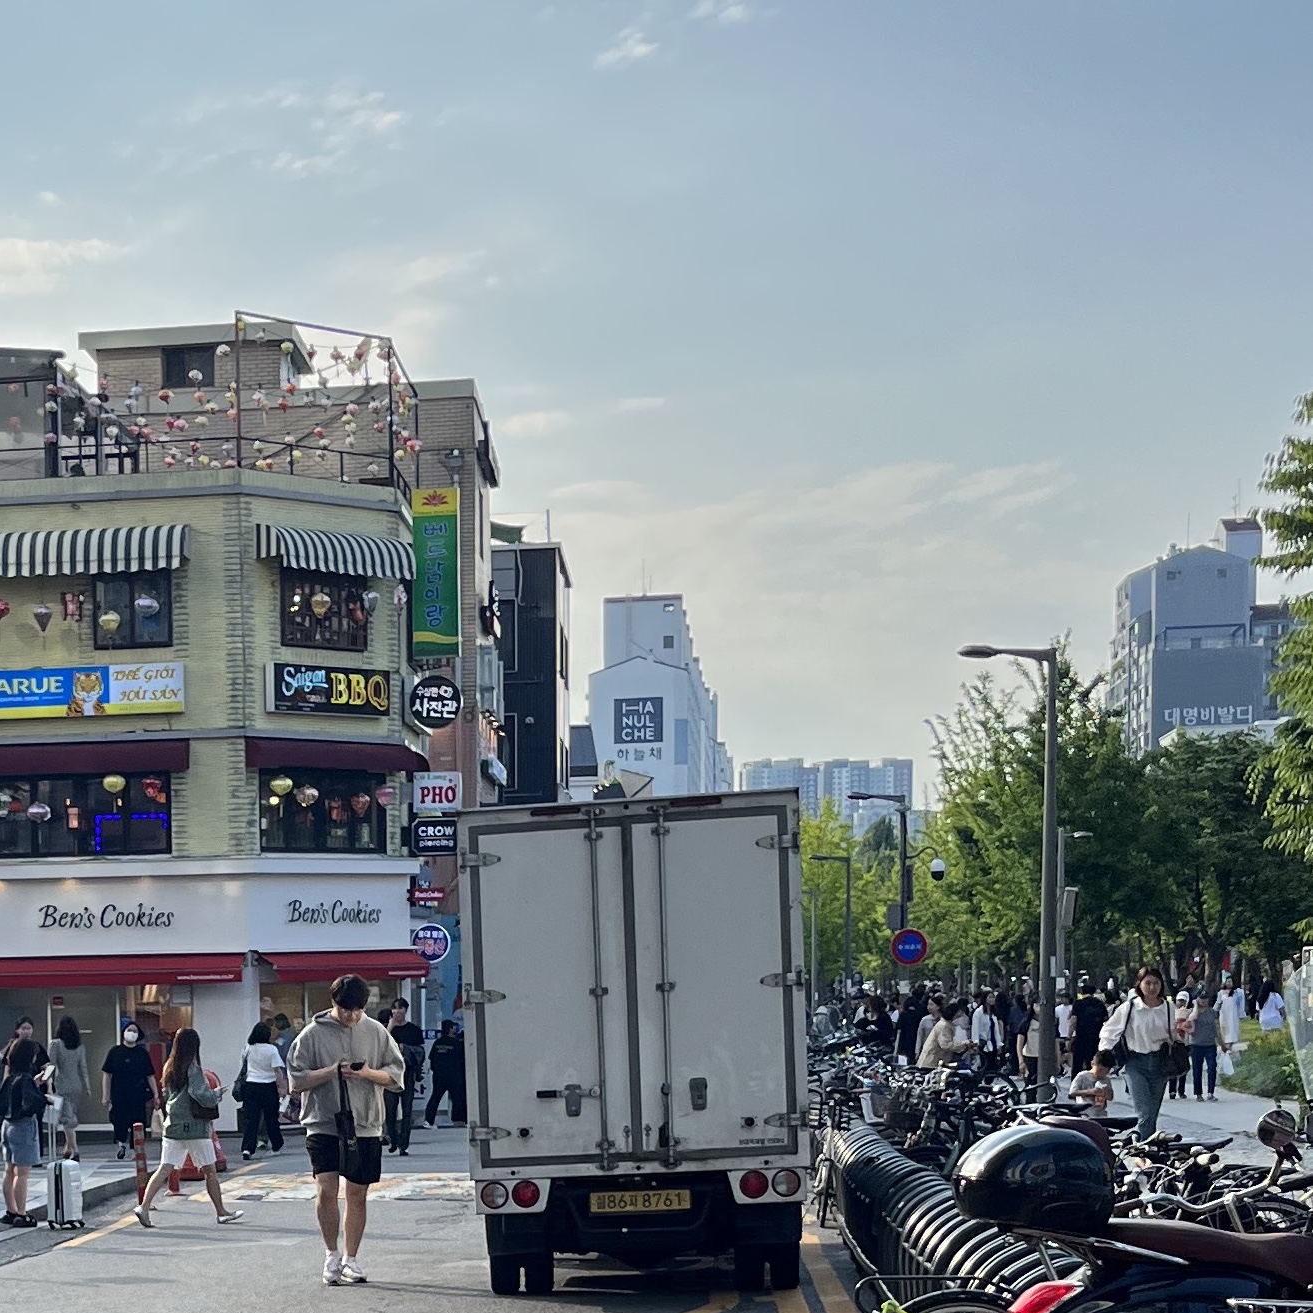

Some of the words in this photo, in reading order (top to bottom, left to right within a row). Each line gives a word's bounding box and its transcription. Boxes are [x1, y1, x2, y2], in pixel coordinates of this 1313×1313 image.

[330, 672, 388, 711] BBQ
[411, 697, 458, 719] 사진관
[622, 700, 655, 714] HA
[1163, 705, 1253, 726] 대명비발디
[622, 714, 655, 728] NUL
[621, 727, 655, 741] CHE
[617, 746, 662, 762] 하늘채
[419, 778, 458, 804] PHỞ
[418, 825, 455, 837] CROW
[419, 838, 455, 849] piercing
[38, 904, 95, 929] Ben's
[99, 903, 175, 929] Cookies
[287, 899, 329, 925] Ben's
[330, 899, 382, 924] Cookies
[642, 1191, 683, 1209] 8761
